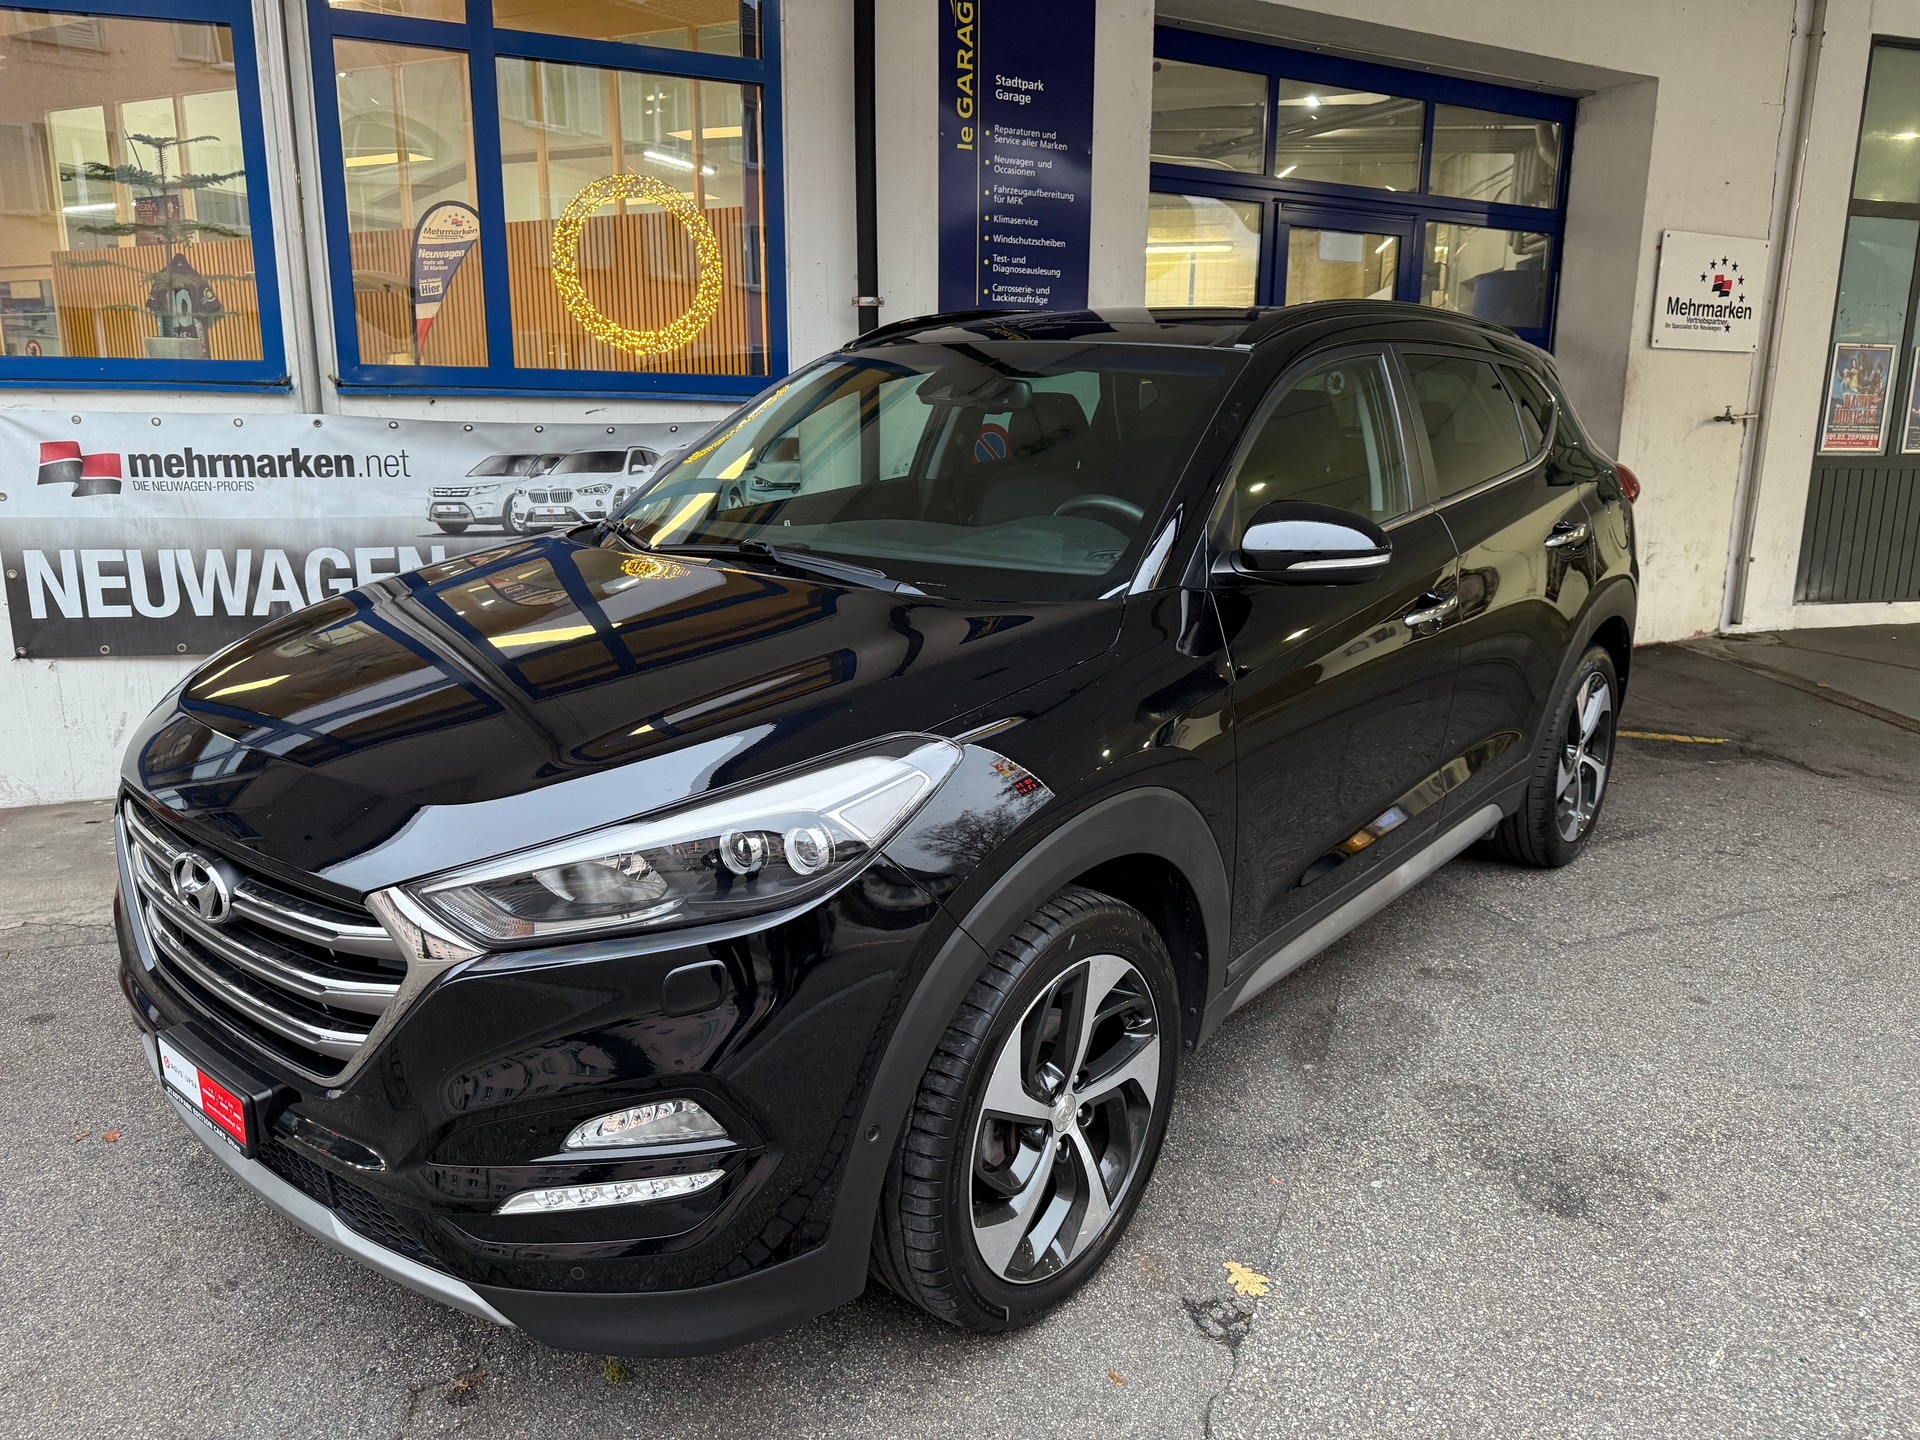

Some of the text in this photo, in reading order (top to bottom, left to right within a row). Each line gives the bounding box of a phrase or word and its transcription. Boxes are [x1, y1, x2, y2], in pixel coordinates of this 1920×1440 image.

[995, 74, 1044, 91] Stadtpark
[995, 88, 1031, 105] Garage
[957, 127, 973, 150] le
[994, 124, 1057, 140] Reparaturen und
[994, 135, 1068, 151] Service aller Marken
[994, 154, 1053, 169] Neuwagen und
[993, 164, 1036, 176] Occasionen
[993, 184, 1075, 202] Fahrzeugaufbereitung
[993, 194, 1024, 205] für MFK
[993, 214, 1039, 226] Klimaservice
[423, 227, 478, 235] Mehrmarken
[992, 234, 1066, 248] Windschutzscheiben
[418, 248, 466, 260] Neuwagen
[992, 253, 1027, 264] Test- und
[992, 264, 1061, 278] Diagnoseauslesung
[421, 283, 441, 295] Hier
[992, 283, 1051, 295] Carrosserie- und
[992, 293, 1049, 306] Lackieraufträge
[1666, 296, 1752, 320] Mehrmarken
[1847, 433, 1879, 441] ZOFINGEN
[128, 447, 411, 478] mehrmarken.net
[132, 480, 255, 492] DIE NEUWAGEN-PROFIS
[166, 1085, 193, 1113] STADTPARK
[192, 1107, 213, 1130] EDITION
[213, 1123, 227, 1141] CARS
